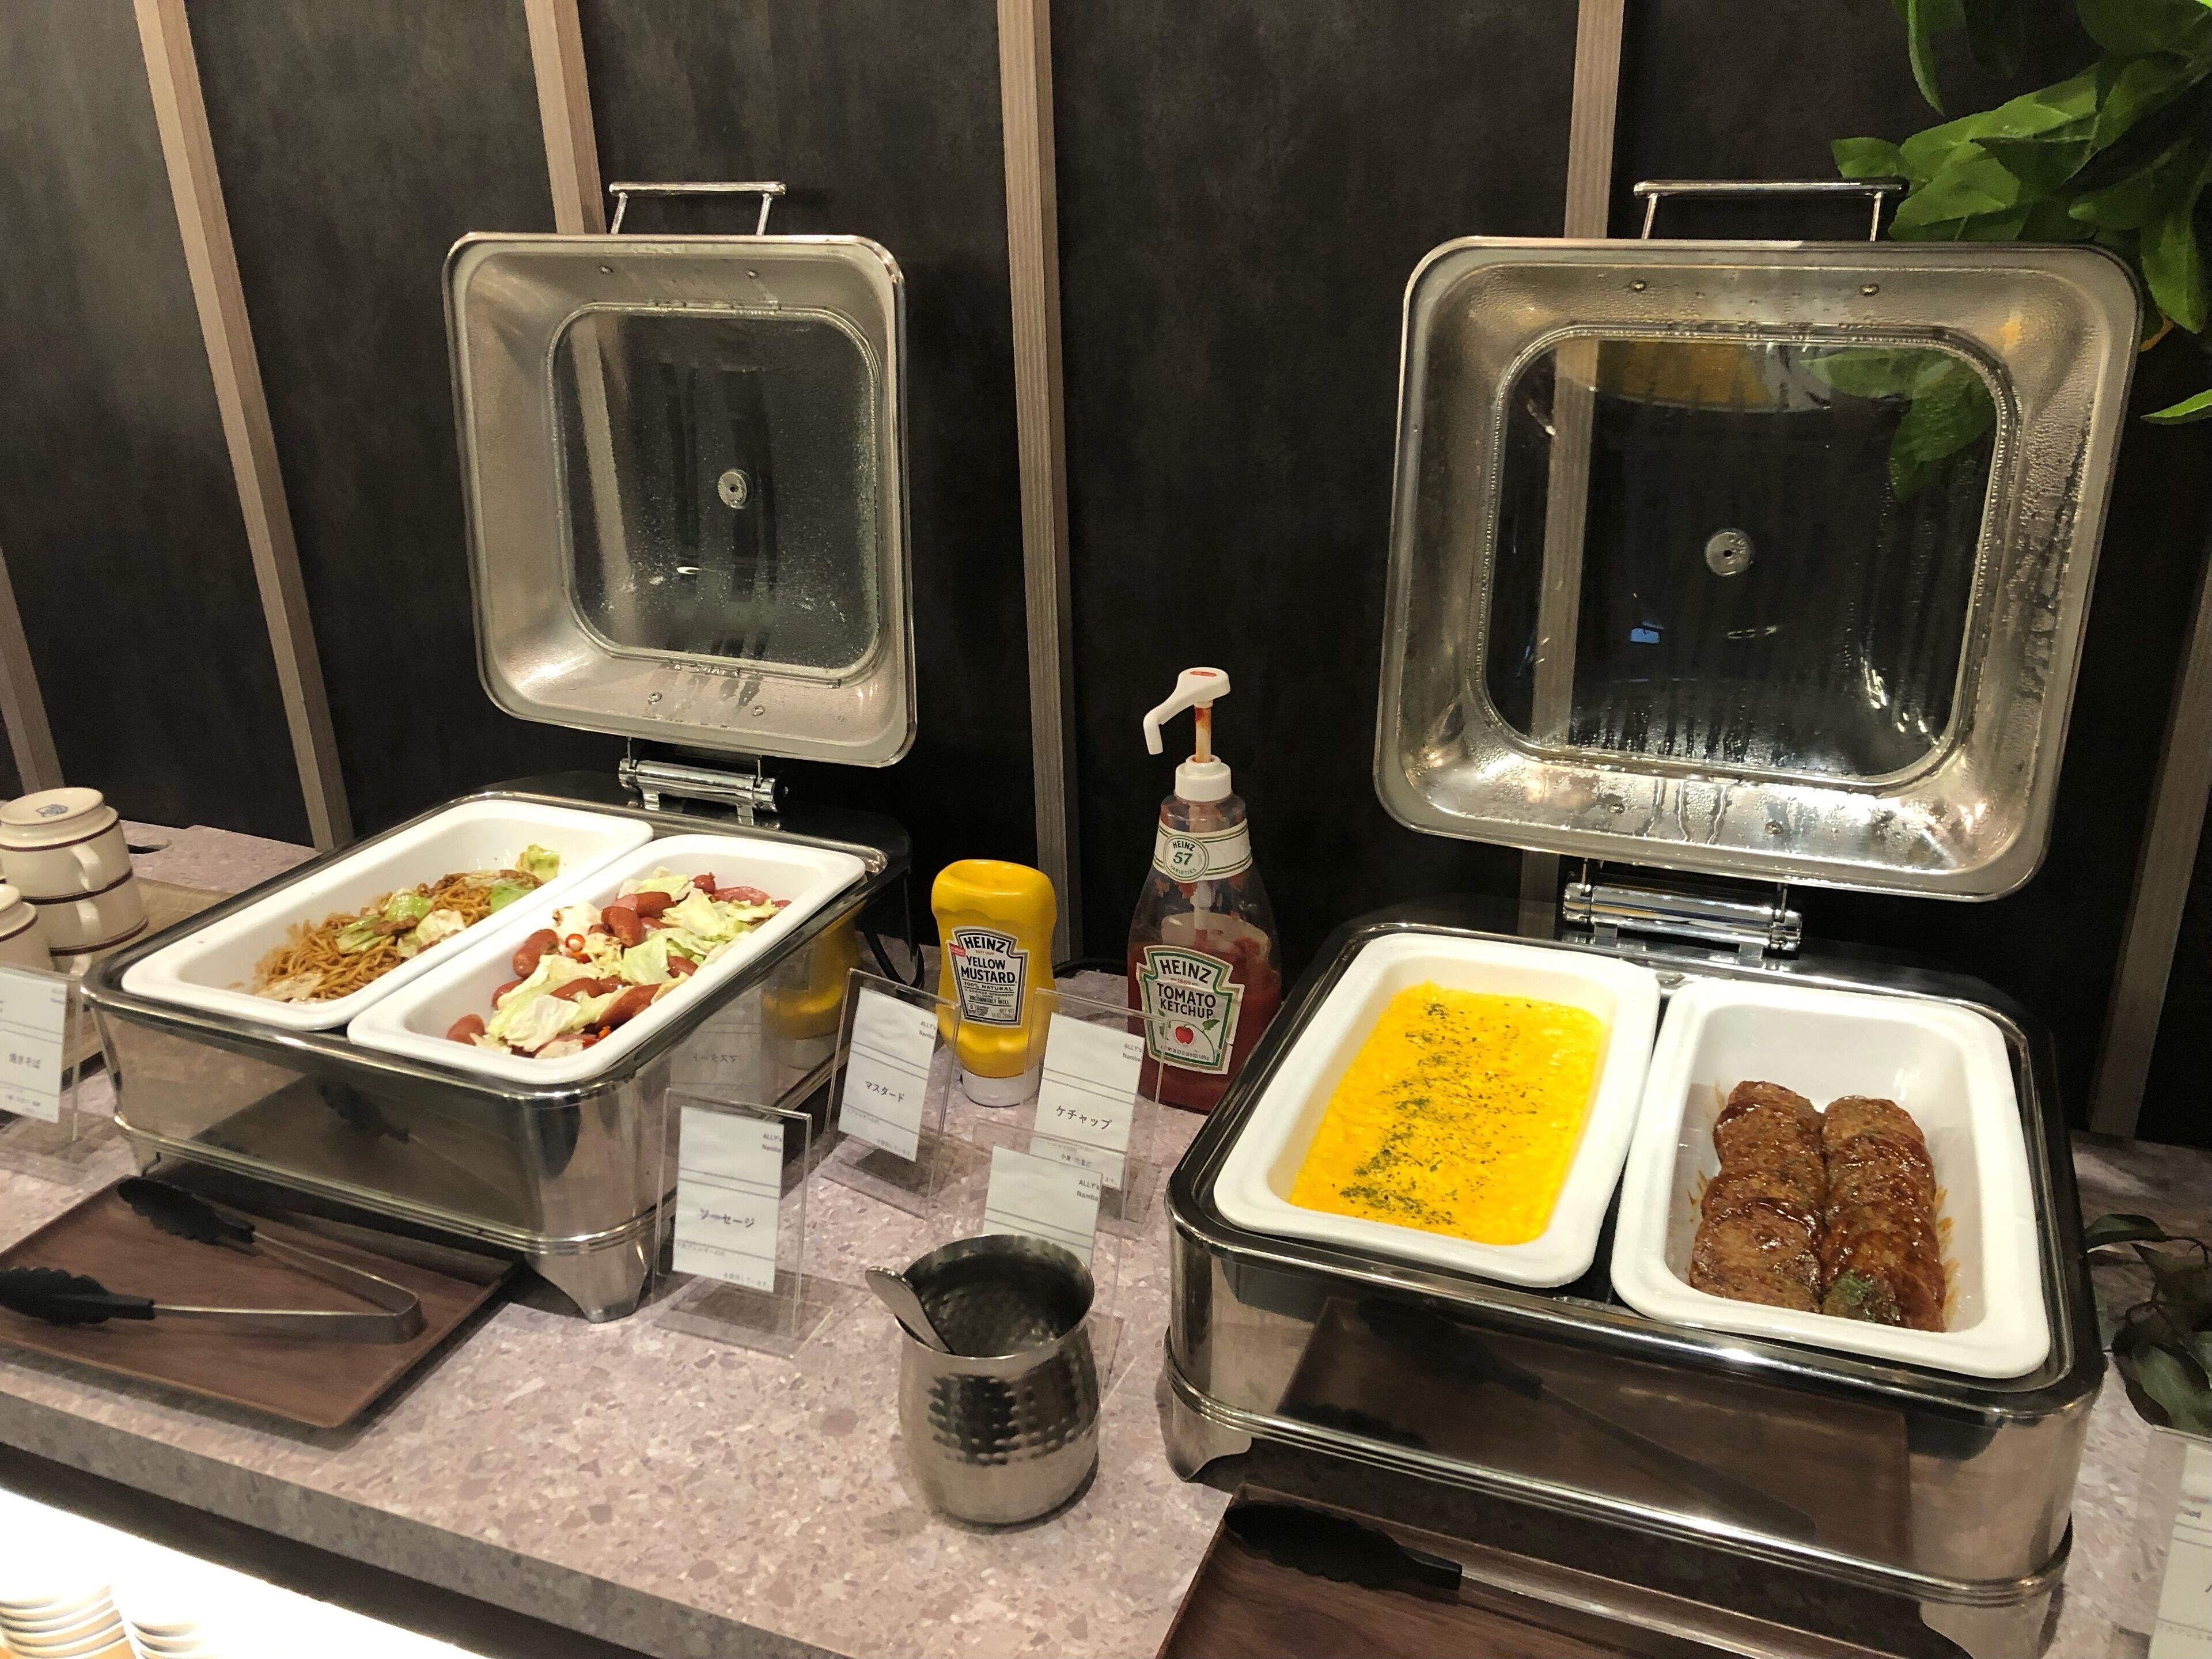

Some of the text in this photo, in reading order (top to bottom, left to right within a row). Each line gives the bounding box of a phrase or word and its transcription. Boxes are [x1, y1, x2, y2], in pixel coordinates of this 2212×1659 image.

[1172, 840, 1196, 852] HEINZ
[1172, 851, 1194, 865] 57
[1169, 864, 1198, 875] VARIETIES
[963, 936, 1006, 954] HEINZ
[966, 955, 1006, 970] YELLOW
[1159, 959, 1212, 984] HEINZ
[960, 965, 1016, 984] MUSTARD
[1157, 982, 1217, 1009] TOMATO
[1160, 998, 1214, 1020] KETCHUP
[1123, 1052, 1141, 1062] Namba
[865, 1081, 905, 1103] マスタード
[1056, 1105, 1113, 1130] ケチャップ
[1078, 1179, 1100, 1190] ALLY's
[1077, 1190, 1099, 1202] Namba
[699, 1208, 755, 1228] ソーセージ
